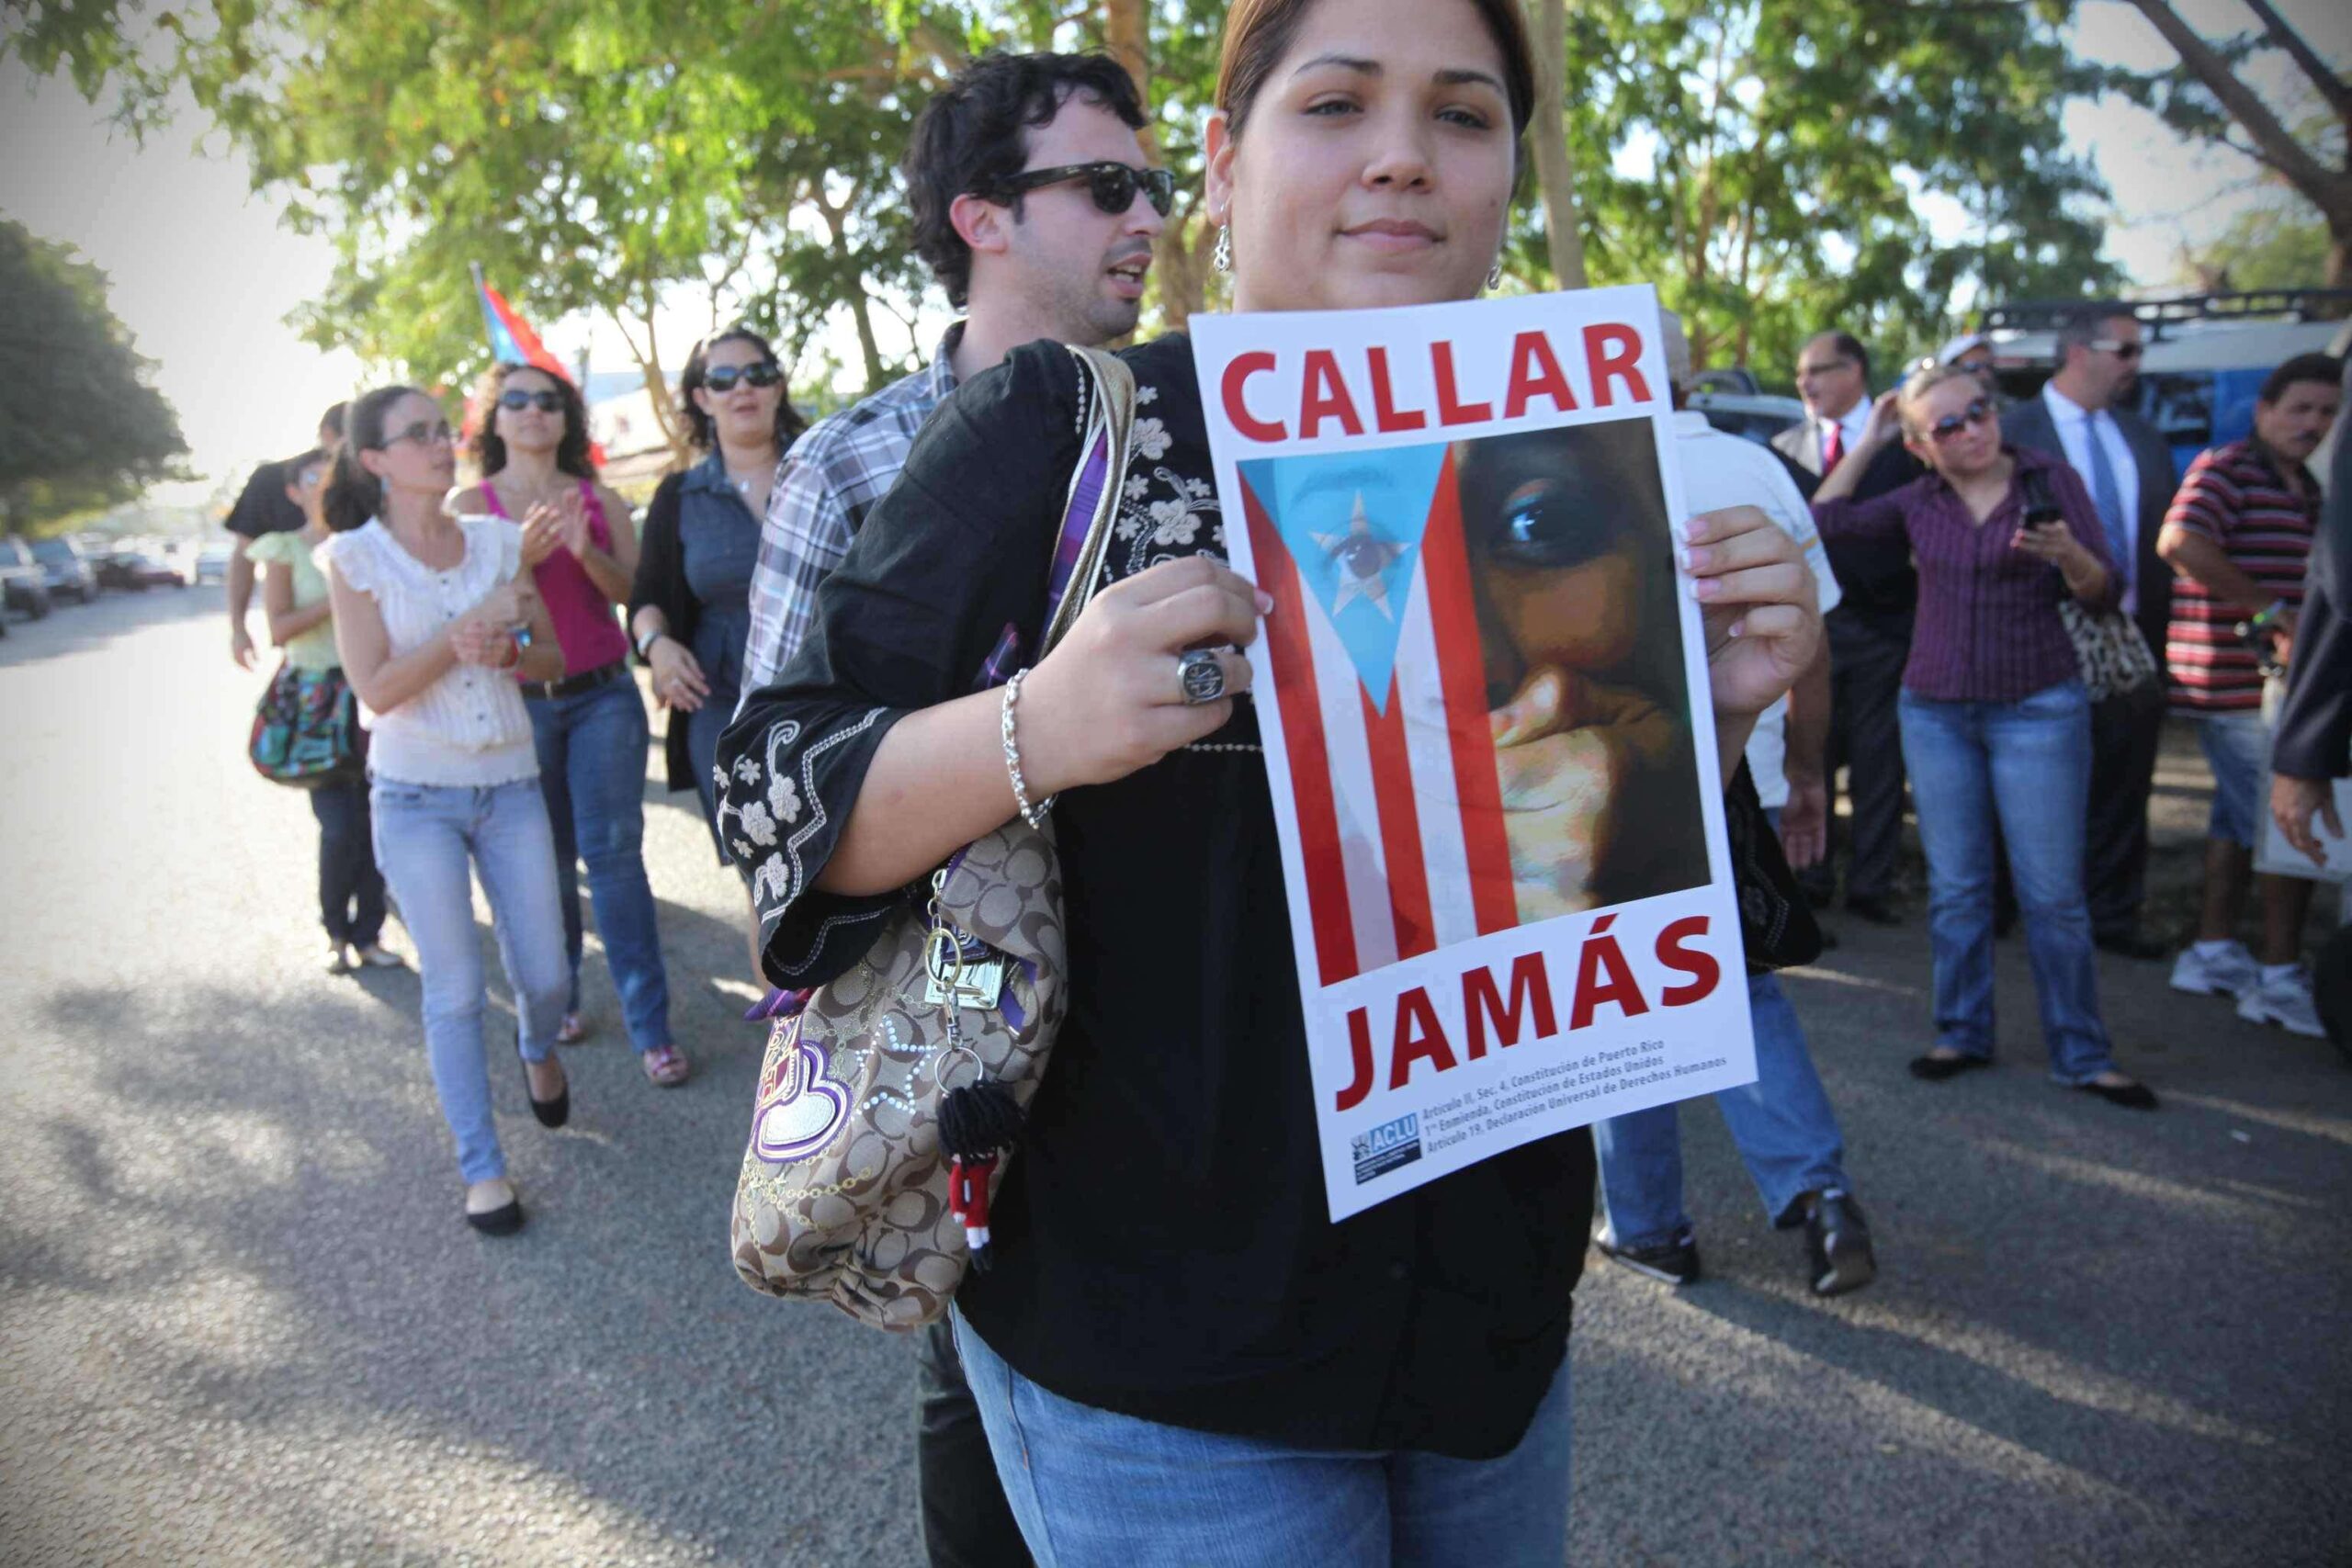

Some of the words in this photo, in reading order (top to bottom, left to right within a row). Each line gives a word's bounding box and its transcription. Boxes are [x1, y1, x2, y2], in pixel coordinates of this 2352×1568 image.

[1221, 322, 1653, 442] CALLAR
[1336, 913, 1721, 1111] JAMÁS
[1562, 1077, 1577, 1089] de
[1578, 1066, 1622, 1084] Estados
[1624, 1055, 1664, 1073] Unidos
[1582, 1055, 1596, 1067] de
[1599, 1046, 1637, 1063] Puerto
[1640, 1040, 1664, 1054] Rico
[1548, 1084, 1600, 1109] Universal
[1602, 1082, 1618, 1094] de
[1620, 1070, 1672, 1090] Derechos
[1674, 1056, 1727, 1077] Humanos
[1373, 1115, 1417, 1153] ACLU
